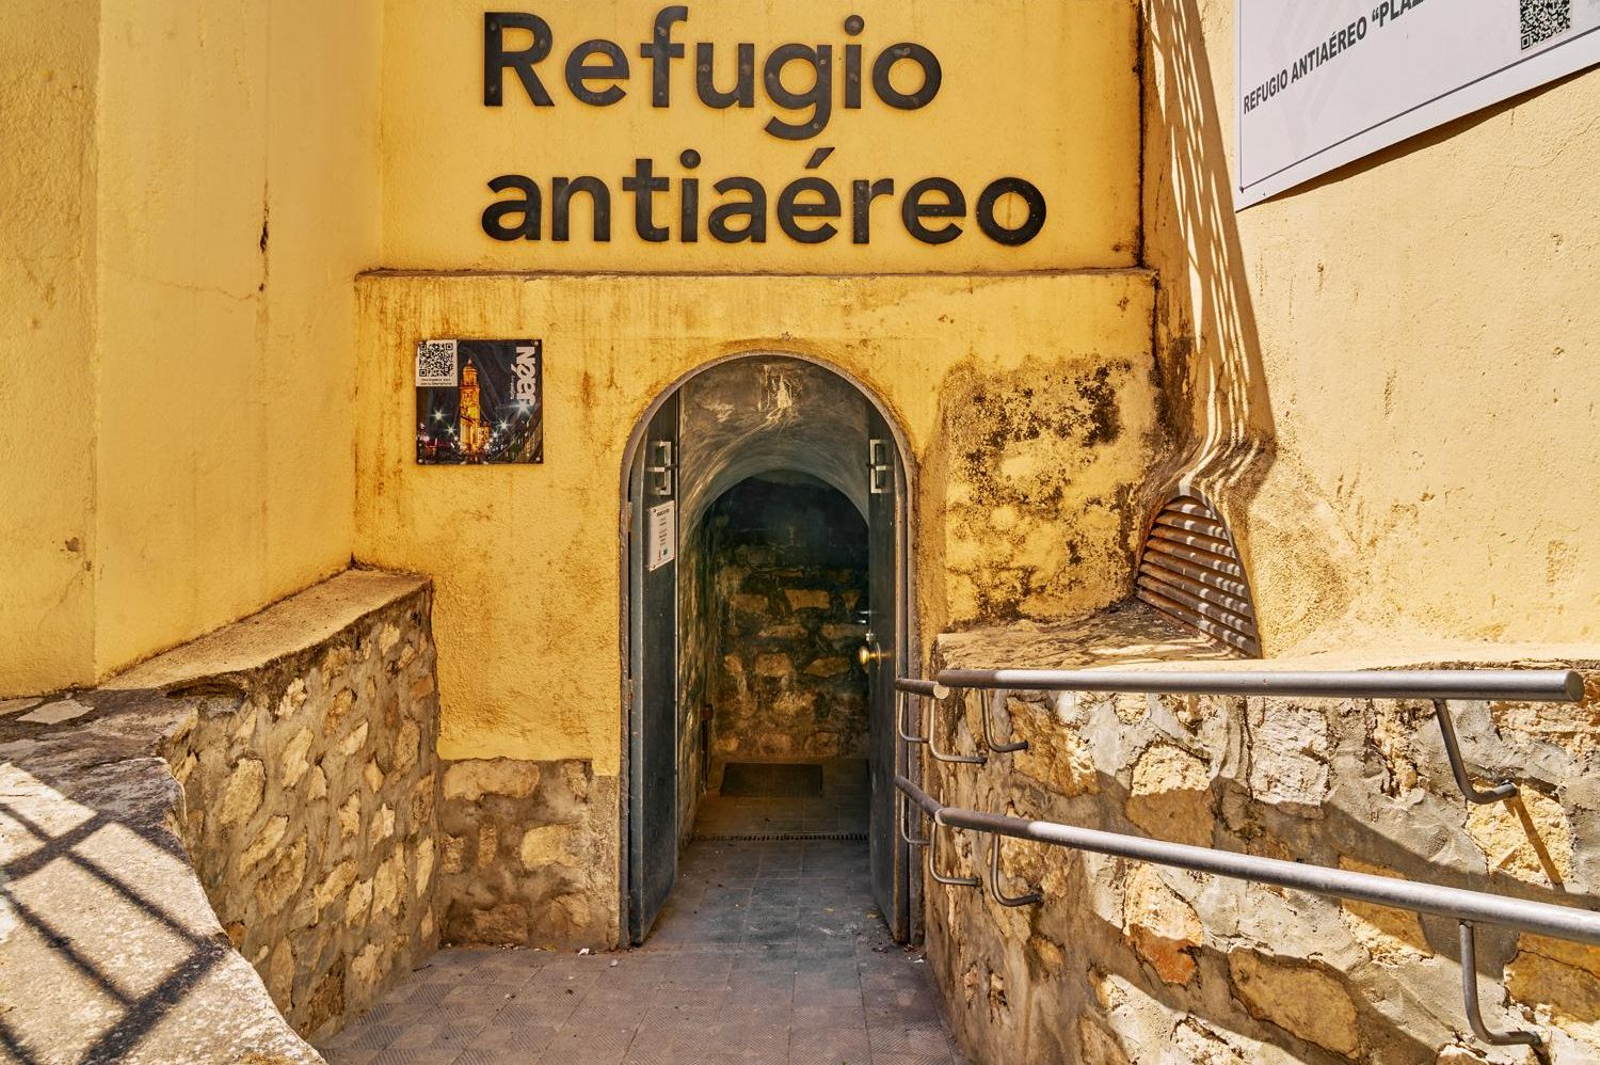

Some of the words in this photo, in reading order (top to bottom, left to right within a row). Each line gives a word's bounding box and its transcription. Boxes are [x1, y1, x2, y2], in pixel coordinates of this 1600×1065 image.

[484, 6, 943, 141] Refugio
[1243, 69, 1288, 114] REFUGIO
[1291, 16, 1367, 84] ANTIAÉREO
[481, 147, 1047, 246] antiaéreo
